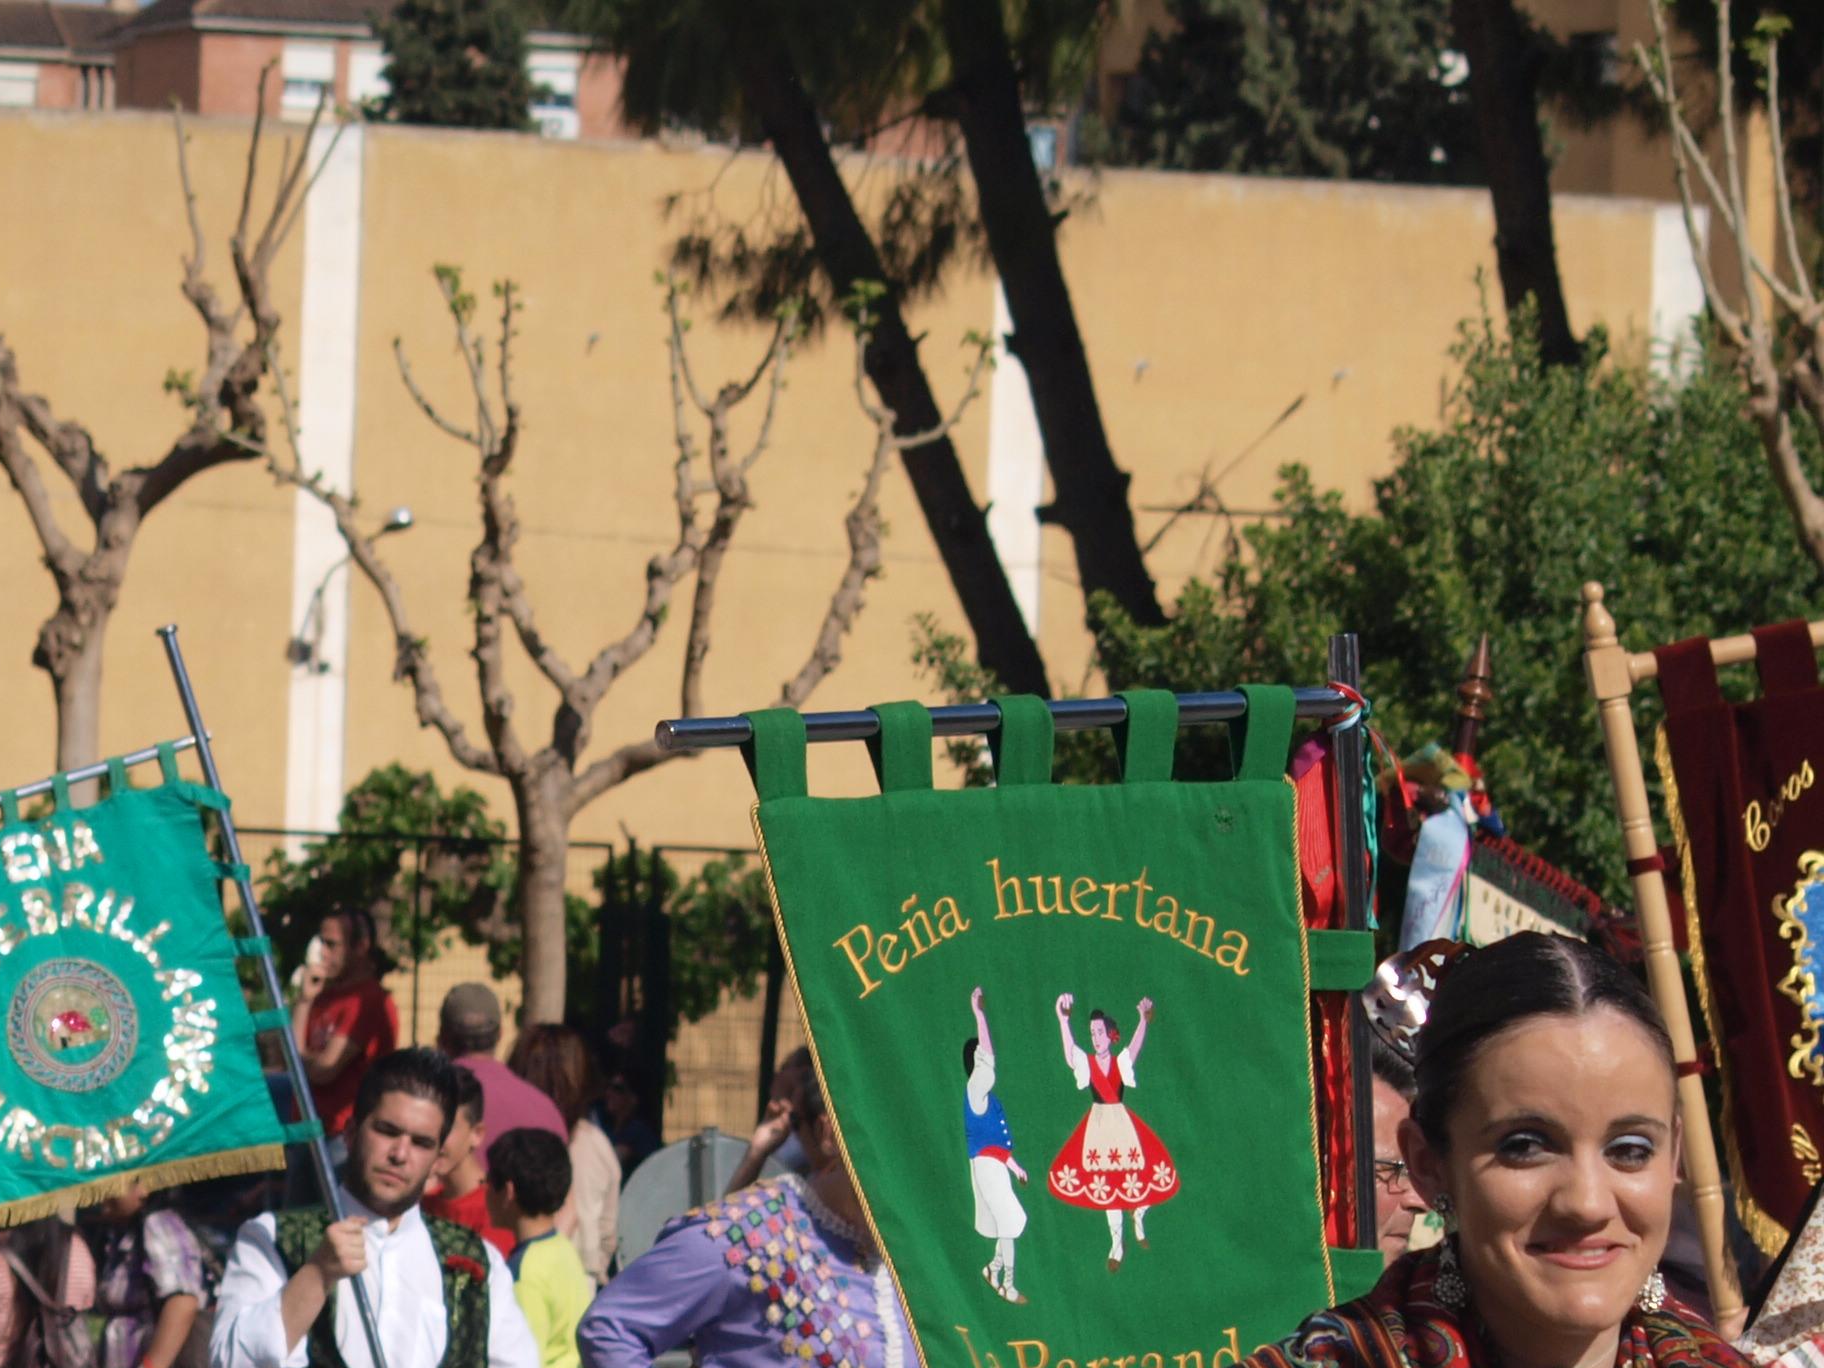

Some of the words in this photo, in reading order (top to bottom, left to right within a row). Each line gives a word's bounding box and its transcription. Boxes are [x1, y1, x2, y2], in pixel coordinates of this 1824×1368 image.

[1742, 758, 1814, 851] Coros
[832, 893, 971, 1000] Peña
[986, 858, 1251, 977] huertana
